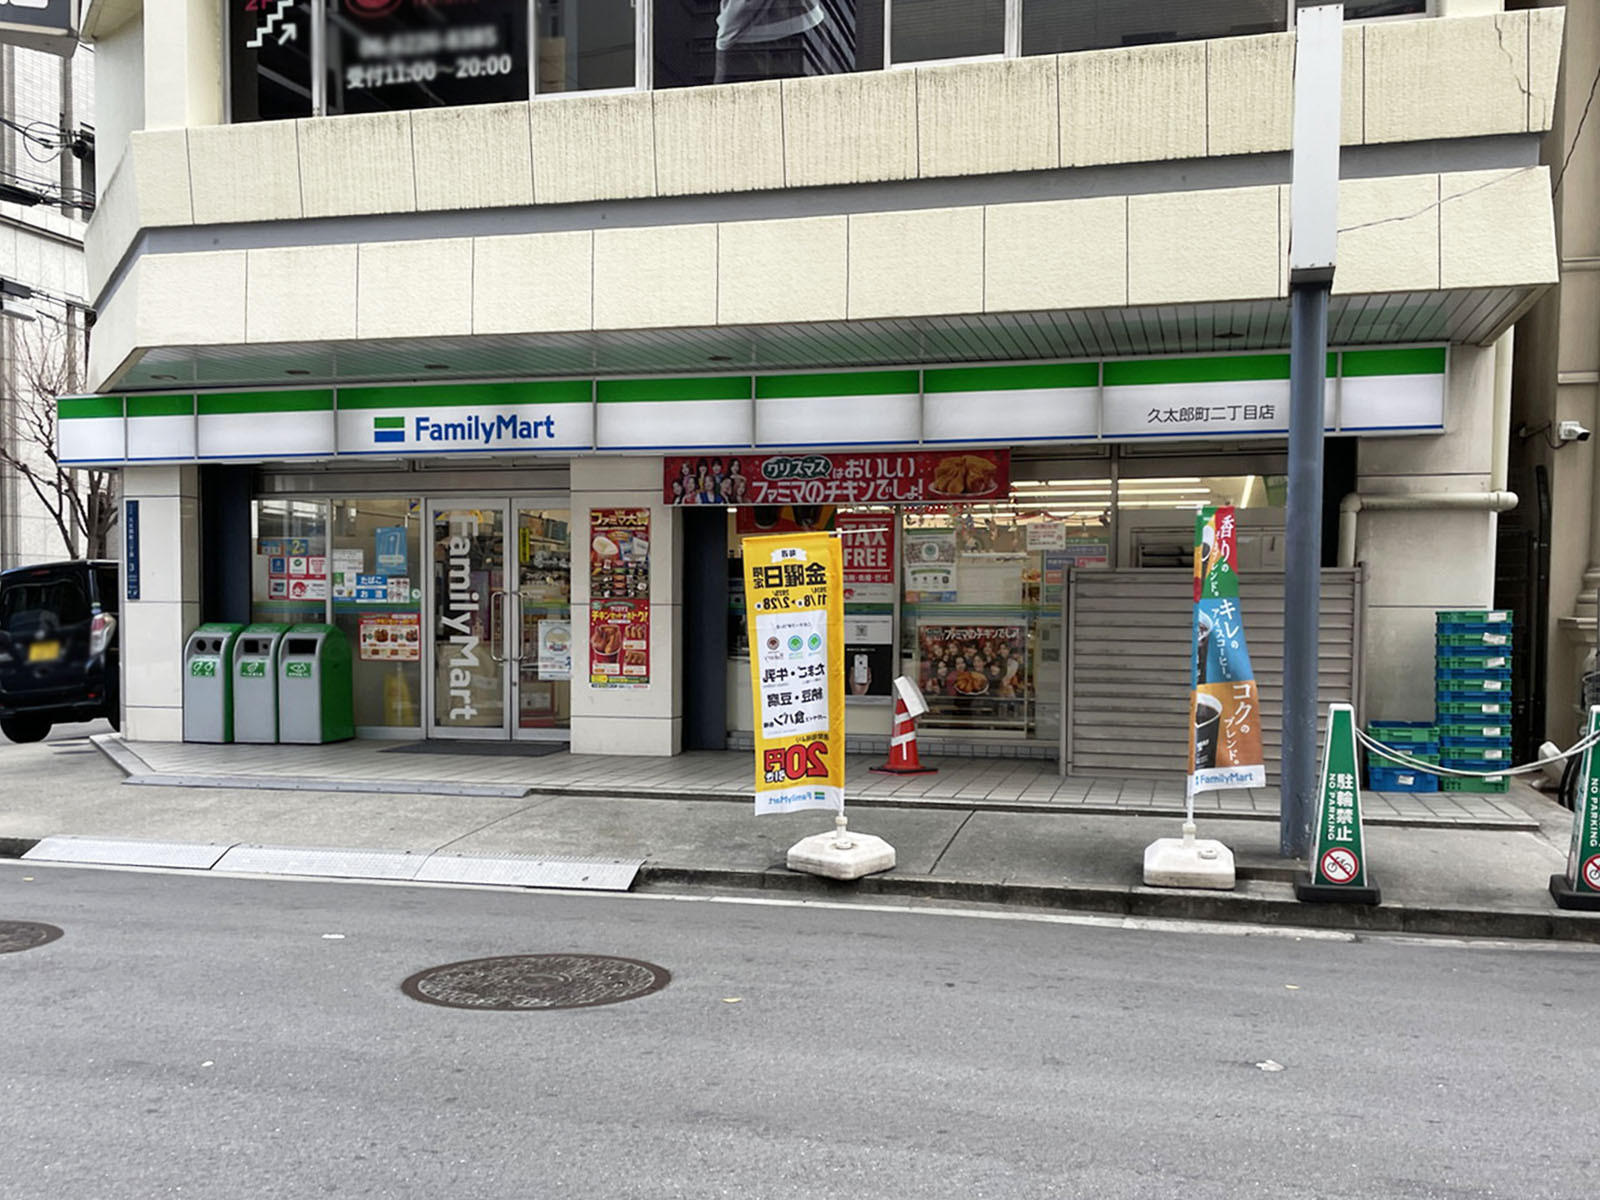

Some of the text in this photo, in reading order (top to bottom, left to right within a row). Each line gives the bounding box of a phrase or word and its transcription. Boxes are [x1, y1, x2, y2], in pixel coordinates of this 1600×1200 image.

[415, 414, 555, 444] FamilyMart
[1147, 404, 1275, 423] 久太郎町二丁目店
[843, 524, 887, 546] TAX
[843, 547, 888, 568] FREE
[1220, 514, 1235, 573] 香りの
[441, 514, 480, 721] FamilyMart
[1220, 599, 1240, 650] キレの
[1233, 683, 1253, 735] コクの
[1200, 771, 1254, 785] FamilyMart
[1327, 773, 1336, 841] NO PARKING
[1335, 773, 1354, 842] 駐輪禁止
[1589, 777, 1599, 848] NO PARKING
